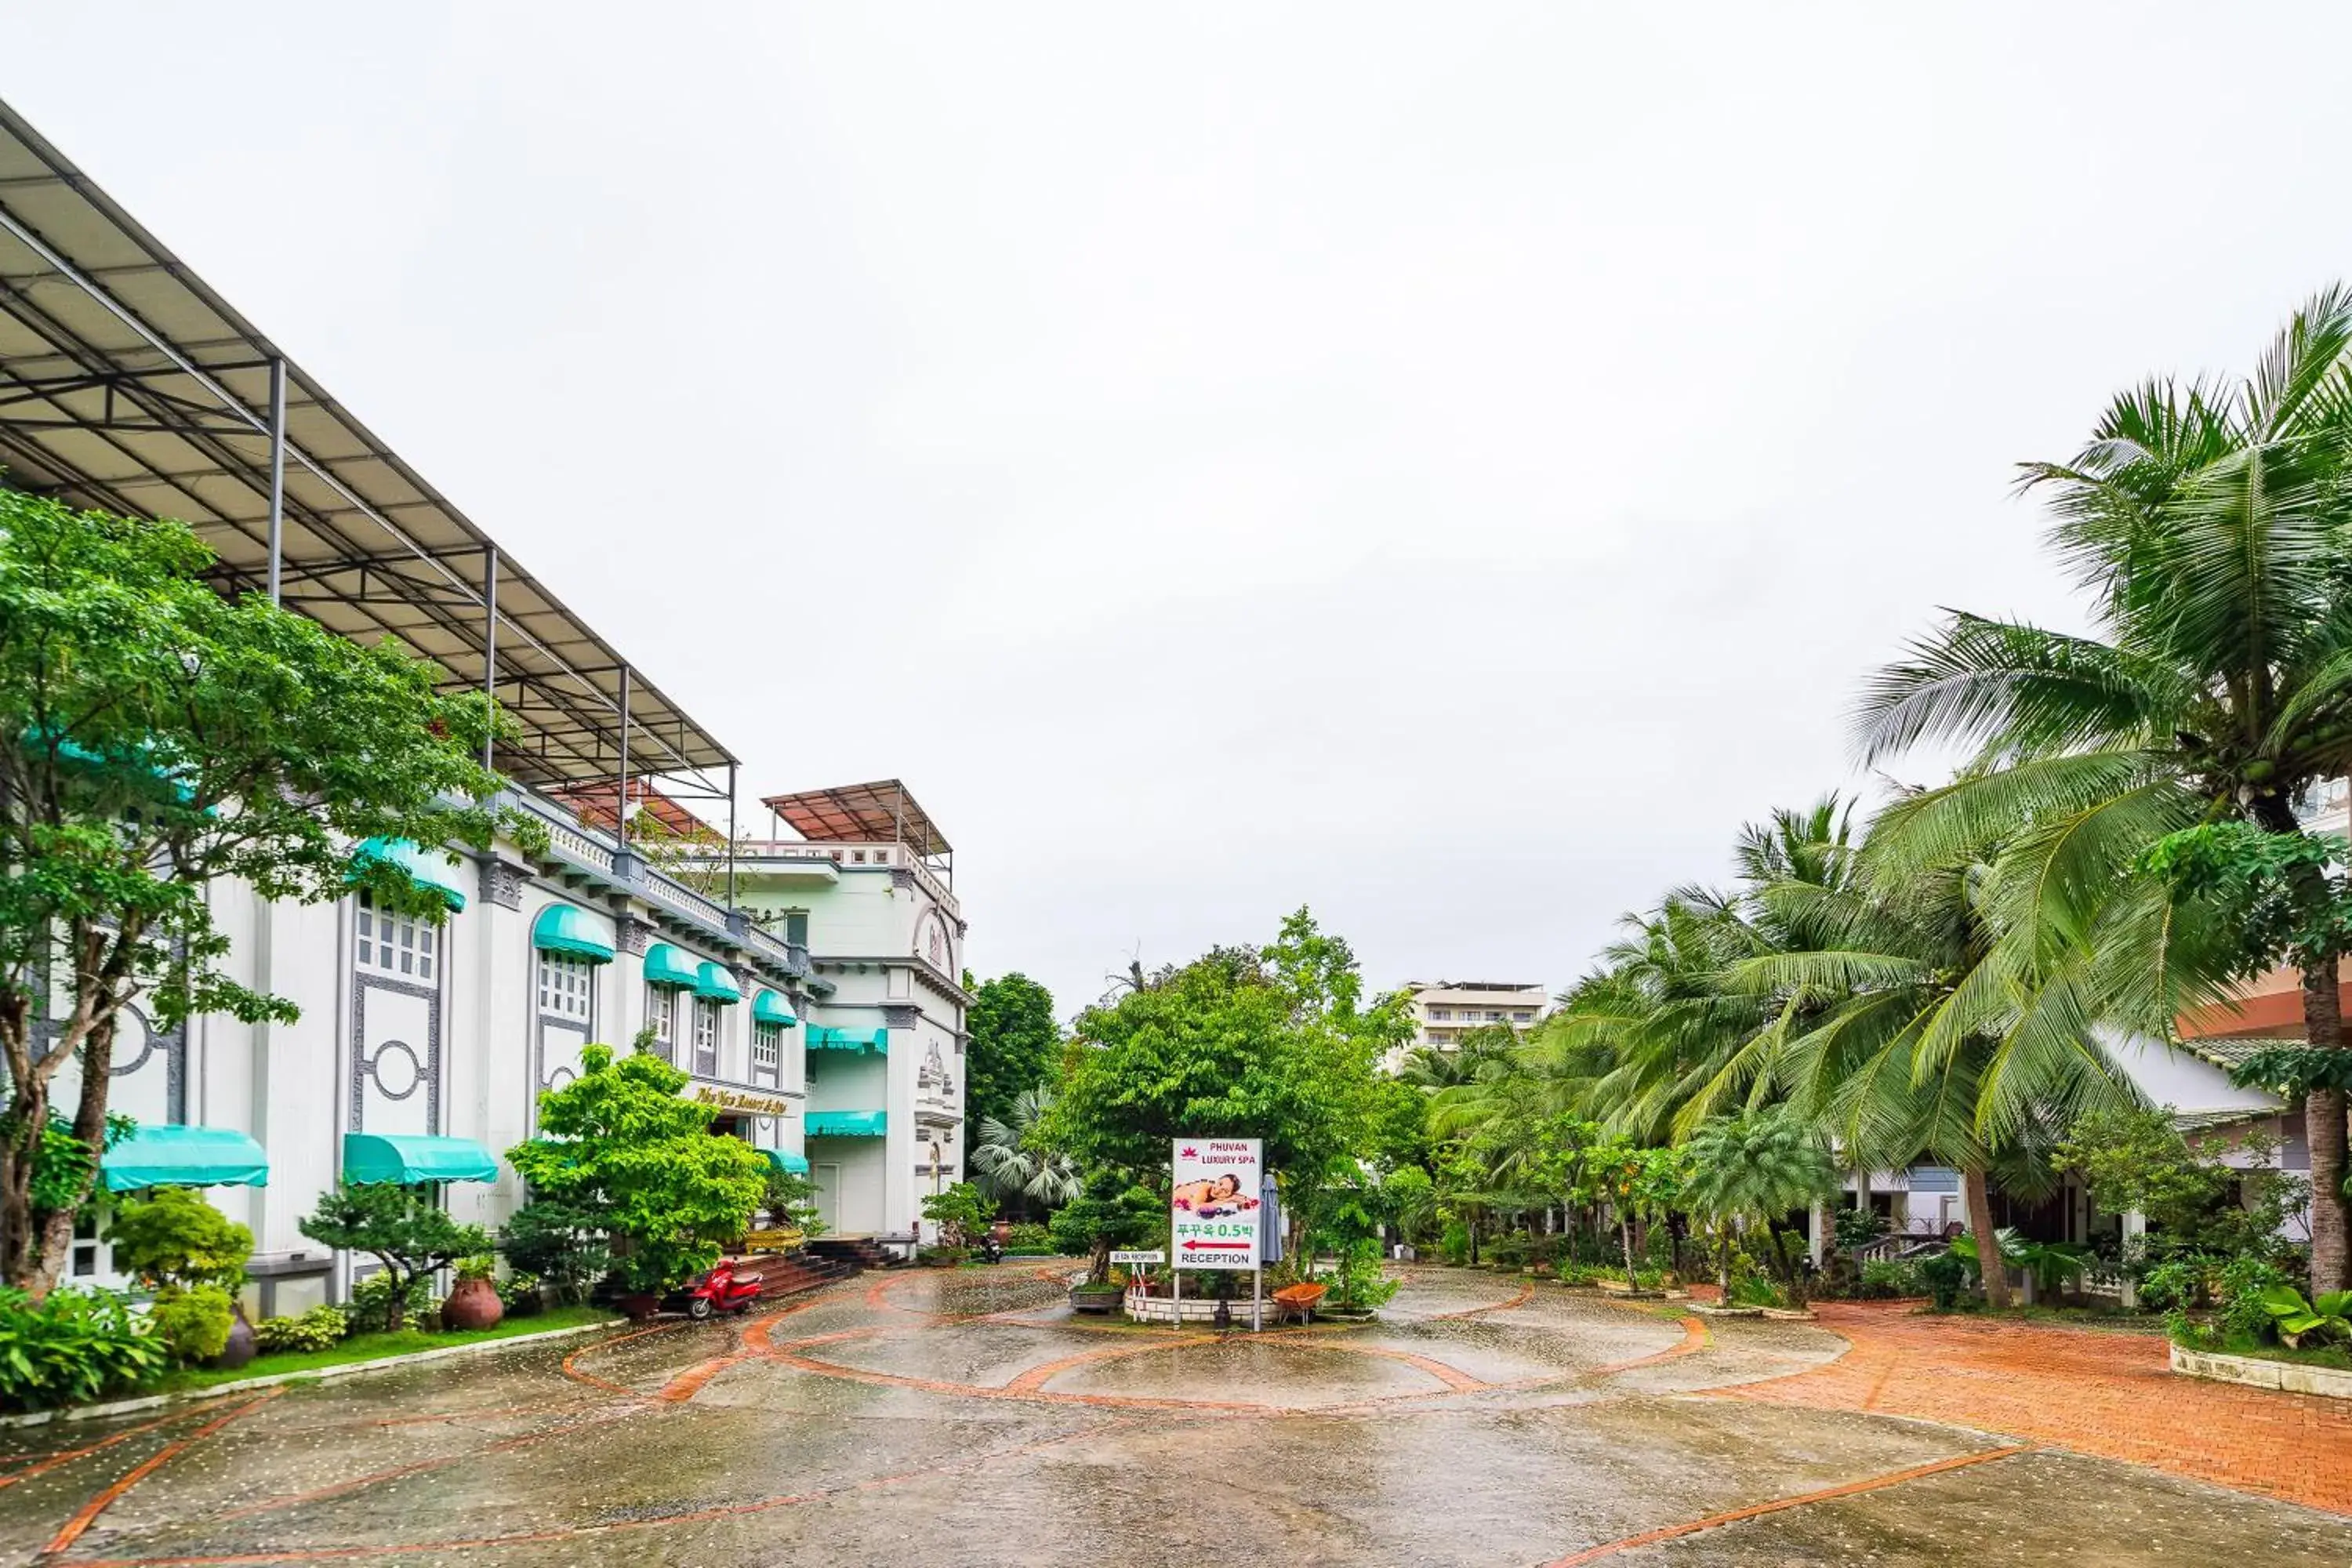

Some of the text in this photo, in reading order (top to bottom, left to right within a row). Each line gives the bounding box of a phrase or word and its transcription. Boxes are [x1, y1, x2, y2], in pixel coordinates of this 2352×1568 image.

[1210, 1142, 1247, 1152] PHUVAN
[1202, 1156, 1255, 1164] LUXURY SPA
[1177, 1224, 1214, 1237] 푸꾸옥
[1181, 1253, 1249, 1264] RECEPTION
